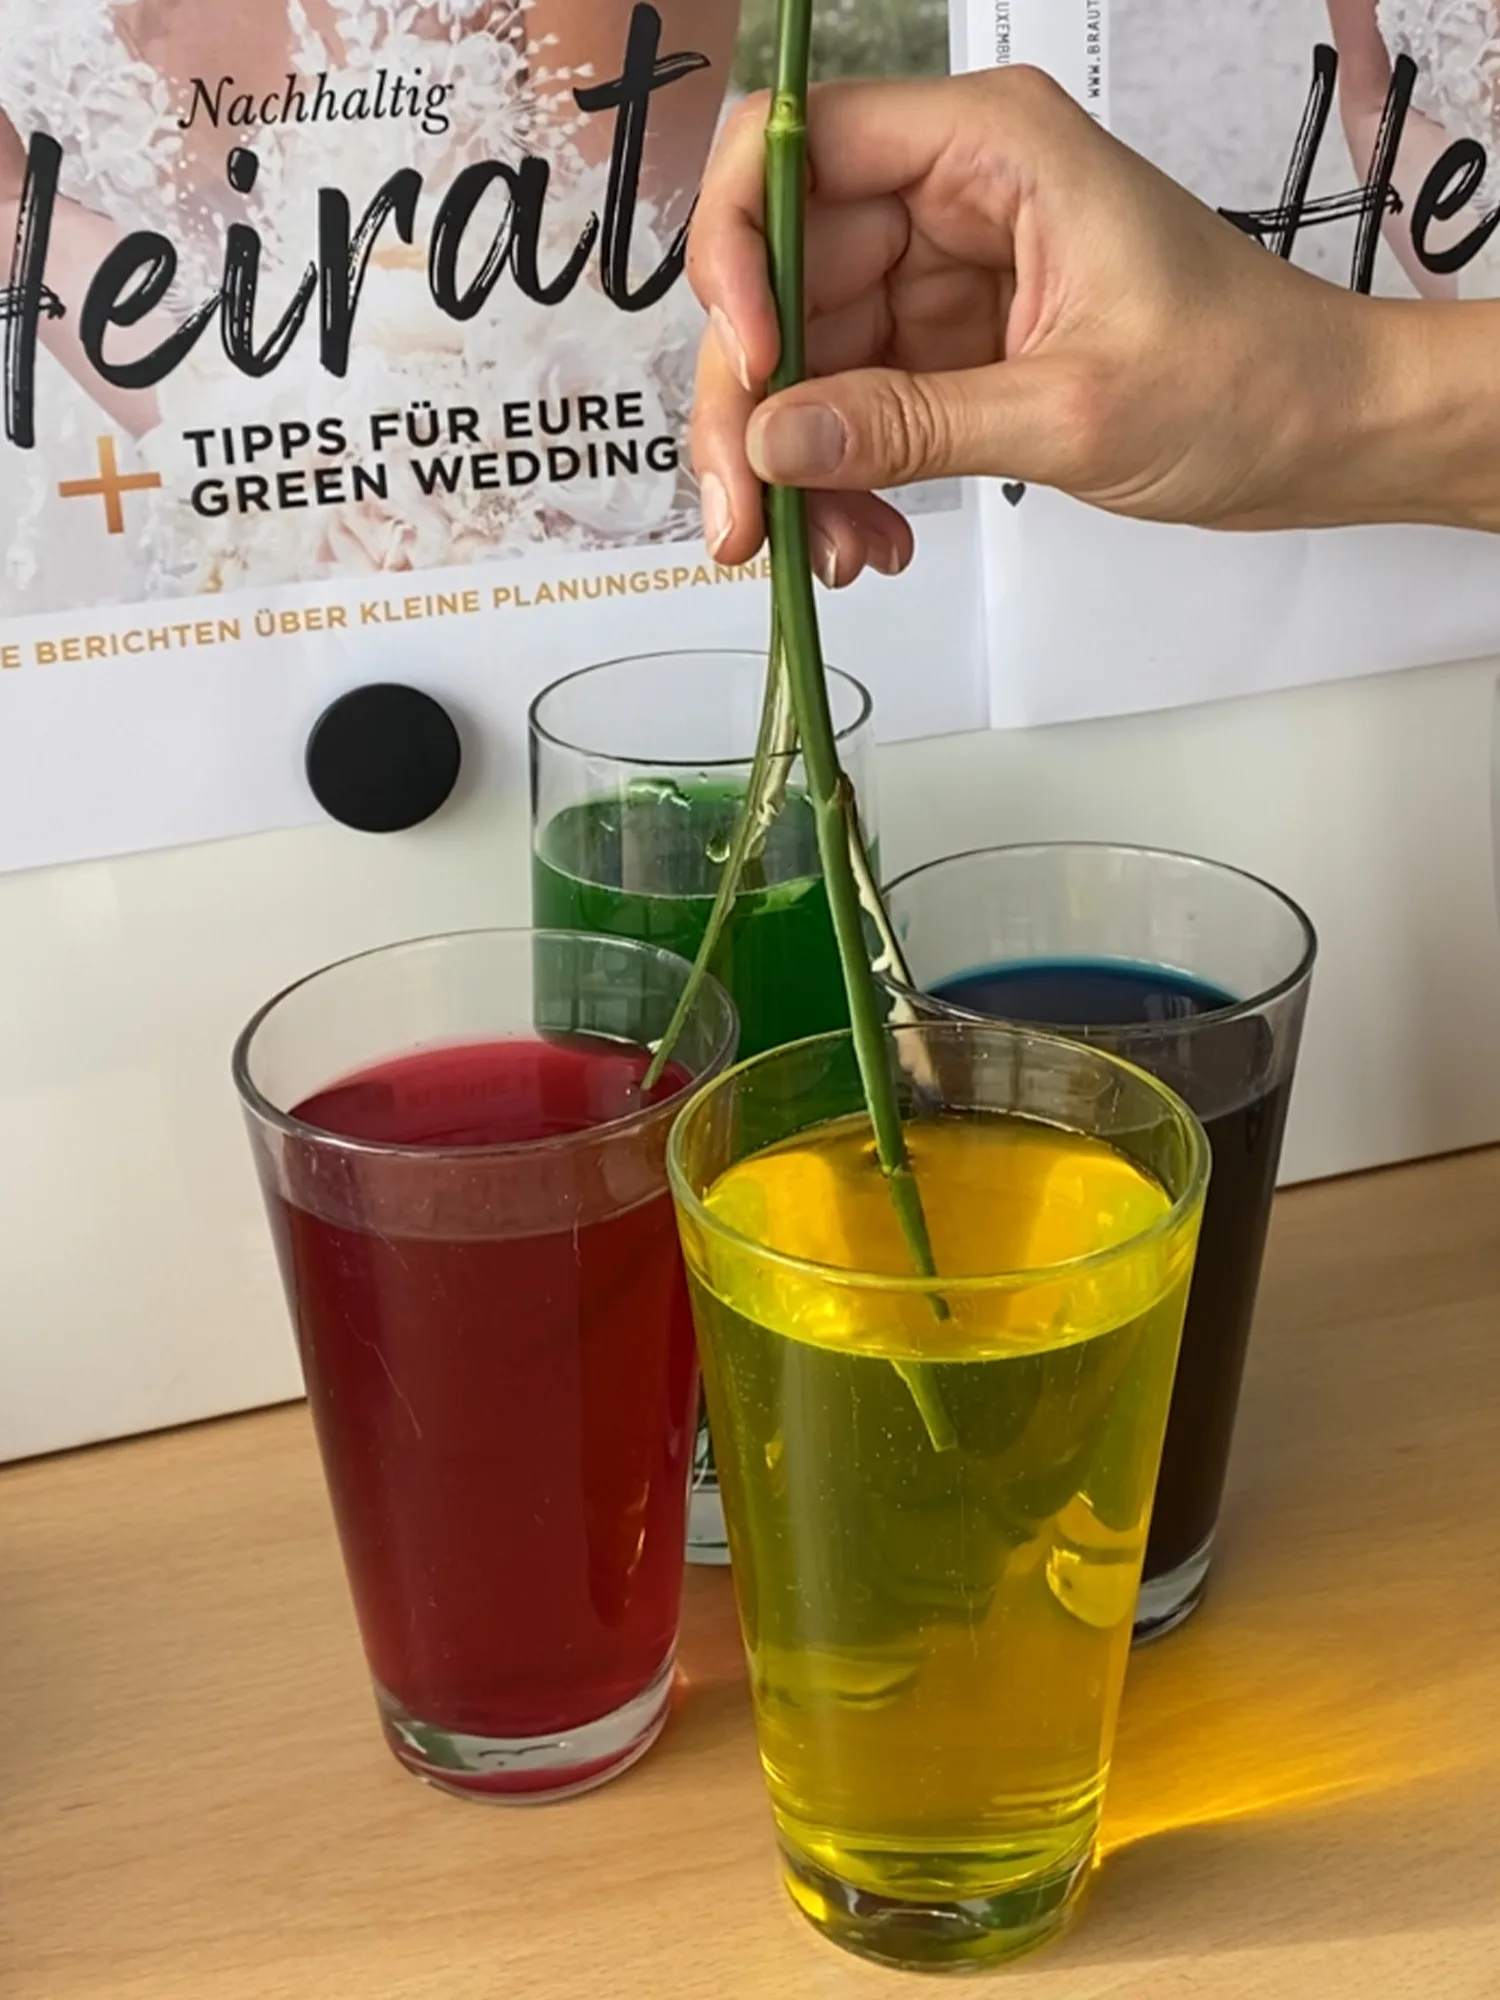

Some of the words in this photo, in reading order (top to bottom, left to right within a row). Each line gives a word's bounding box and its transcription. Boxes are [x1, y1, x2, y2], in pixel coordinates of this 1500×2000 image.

[995, 0, 1010, 64] UXEMBU
[177, 68, 454, 134] Nachhaltig
[183, 417, 347, 467] TIPPS
[370, 400, 481, 450] FÜR
[503, 392, 645, 439] EURE
[191, 463, 388, 518] GREEN
[411, 436, 680, 495] WEDDING
[35, 618, 241, 665] BERICHTEN
[254, 605, 348, 637] ÜBER
[360, 590, 481, 624] KLEINE
